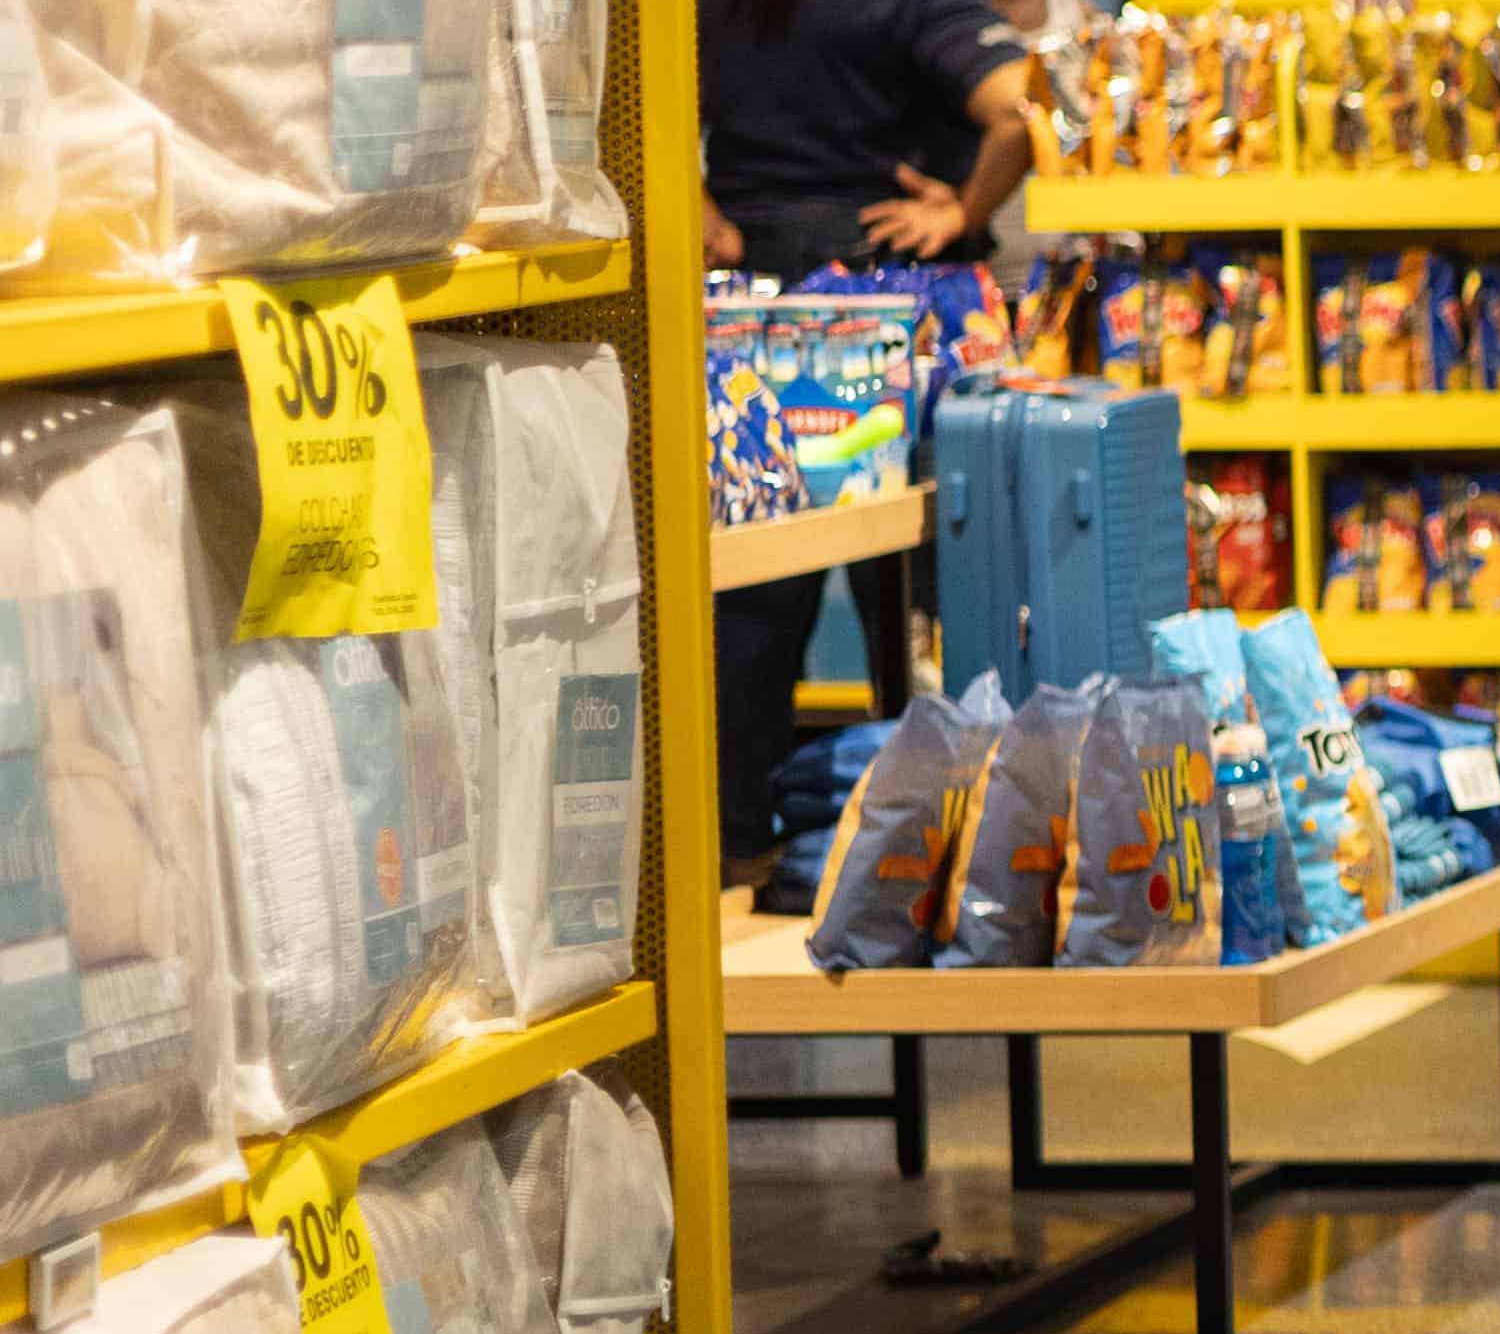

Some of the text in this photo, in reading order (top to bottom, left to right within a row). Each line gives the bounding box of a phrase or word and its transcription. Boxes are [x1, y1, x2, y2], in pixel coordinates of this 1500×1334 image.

[256, 299, 387, 422] 30%
[277, 1195, 361, 1295] 30%
[308, 1264, 371, 1324] DESCUENTO
